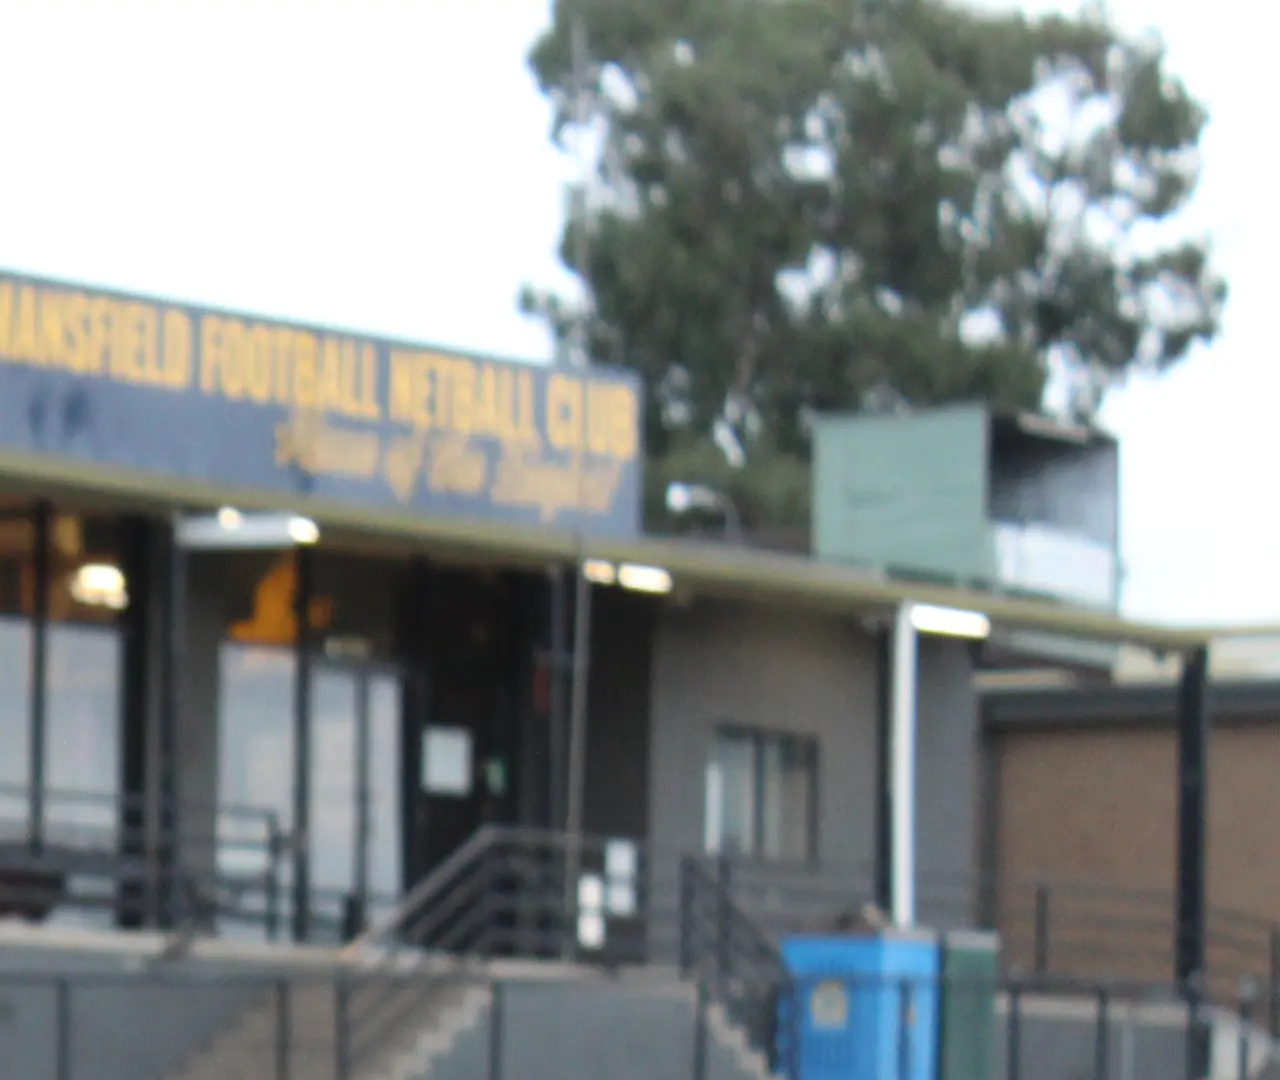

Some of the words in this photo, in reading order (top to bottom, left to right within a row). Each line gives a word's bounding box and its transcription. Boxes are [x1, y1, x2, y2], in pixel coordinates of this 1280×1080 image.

[200, 313, 380, 420] FOOTBALL
[389, 348, 538, 440] NETBALL
[546, 372, 638, 460] CLUB
